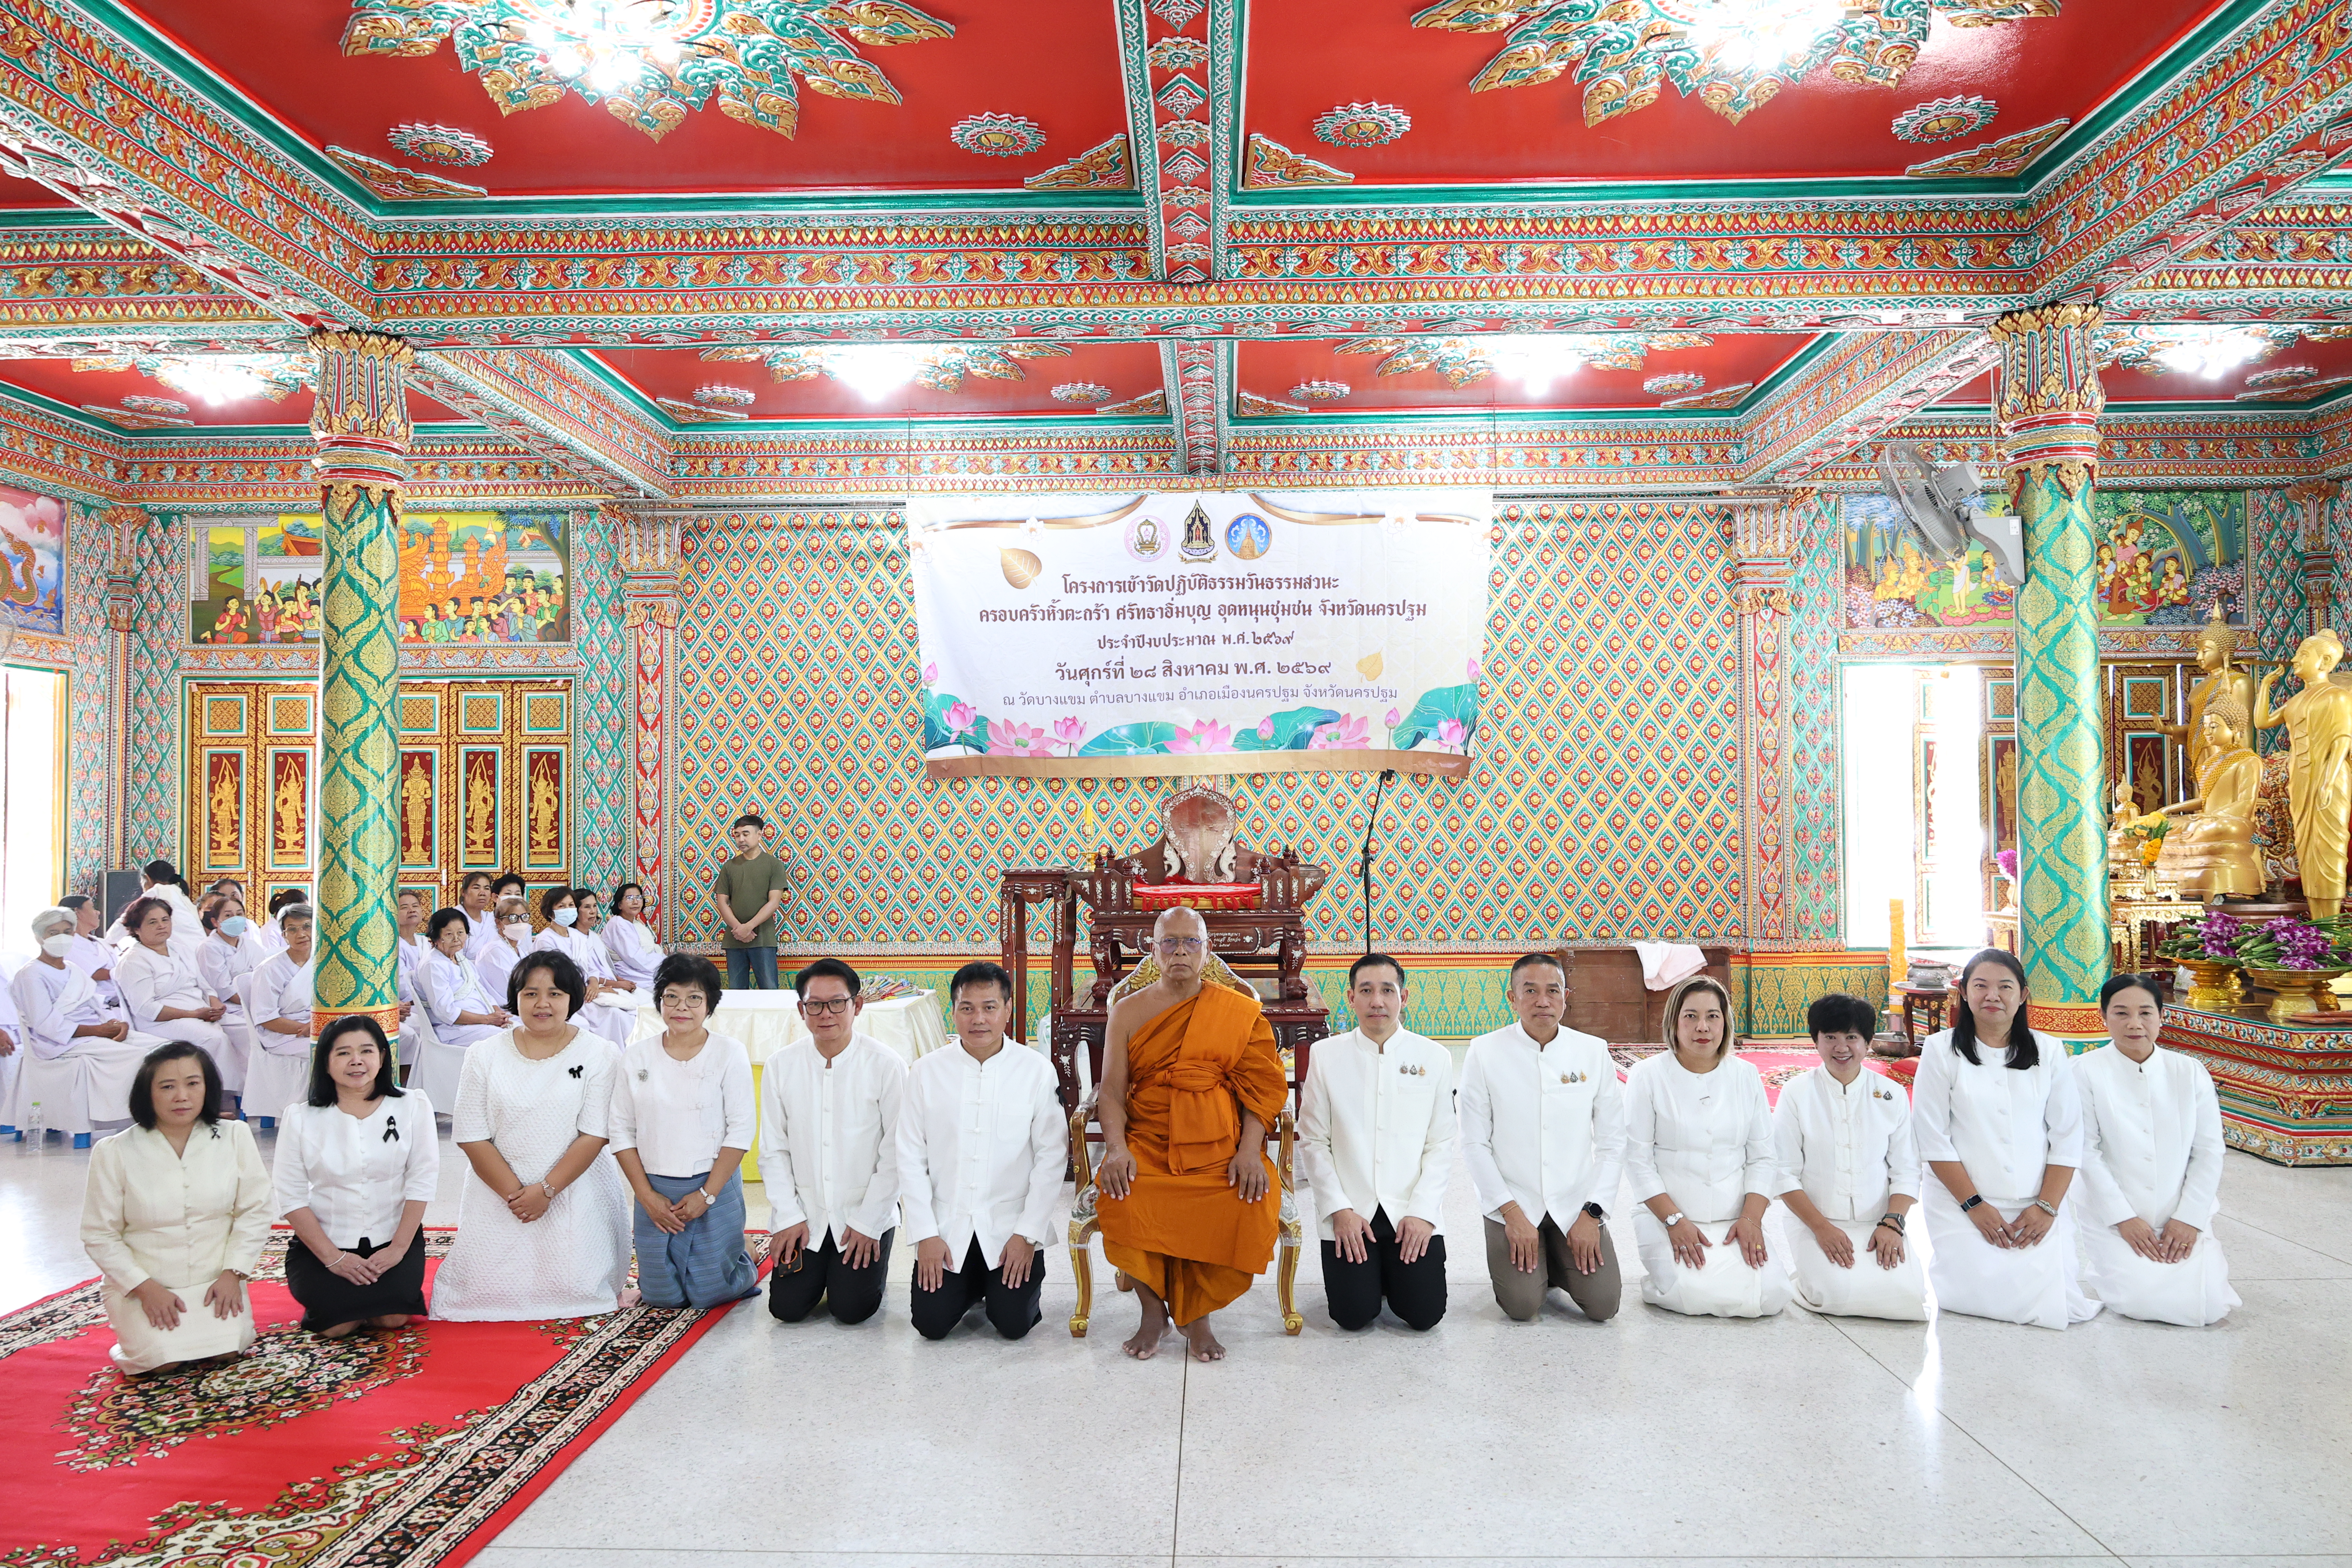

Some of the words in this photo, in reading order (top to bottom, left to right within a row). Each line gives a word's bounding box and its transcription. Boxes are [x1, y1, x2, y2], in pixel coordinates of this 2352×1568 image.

[1062, 573, 1339, 596] โครงการเข้าวัดปฏิบัติธรรมวันธรรมสวนะ
[980, 599, 1109, 622] ครอบครัวหิ้วตะกร้า
[1116, 597, 1211, 624] ศรัทธาอิ่มบุญ
[1218, 600, 1312, 623] อุดหนุนชุมชน
[1318, 599, 1426, 621] จังหวัดนครปฐม
[1097, 633, 1216, 650] ประจำปีงบประมาณ
[1055, 655, 1124, 687] วันศุกร์ที่
[1130, 665, 1156, 679] ๒๘
[1162, 659, 1229, 677] สิงหาคม
[1234, 661, 1271, 674] พ.ศ.
[1277, 662, 1331, 674] ๒๕๖๙
[1003, 696, 1015, 706] ณ
[1019, 691, 1085, 706] วัดบางแขม
[1090, 690, 1174, 704] ตำบลบางแขม
[1179, 685, 1298, 702] อำเภอเมืองนครปฐม
[1303, 684, 1397, 702] จังหวัดนครปฐม
